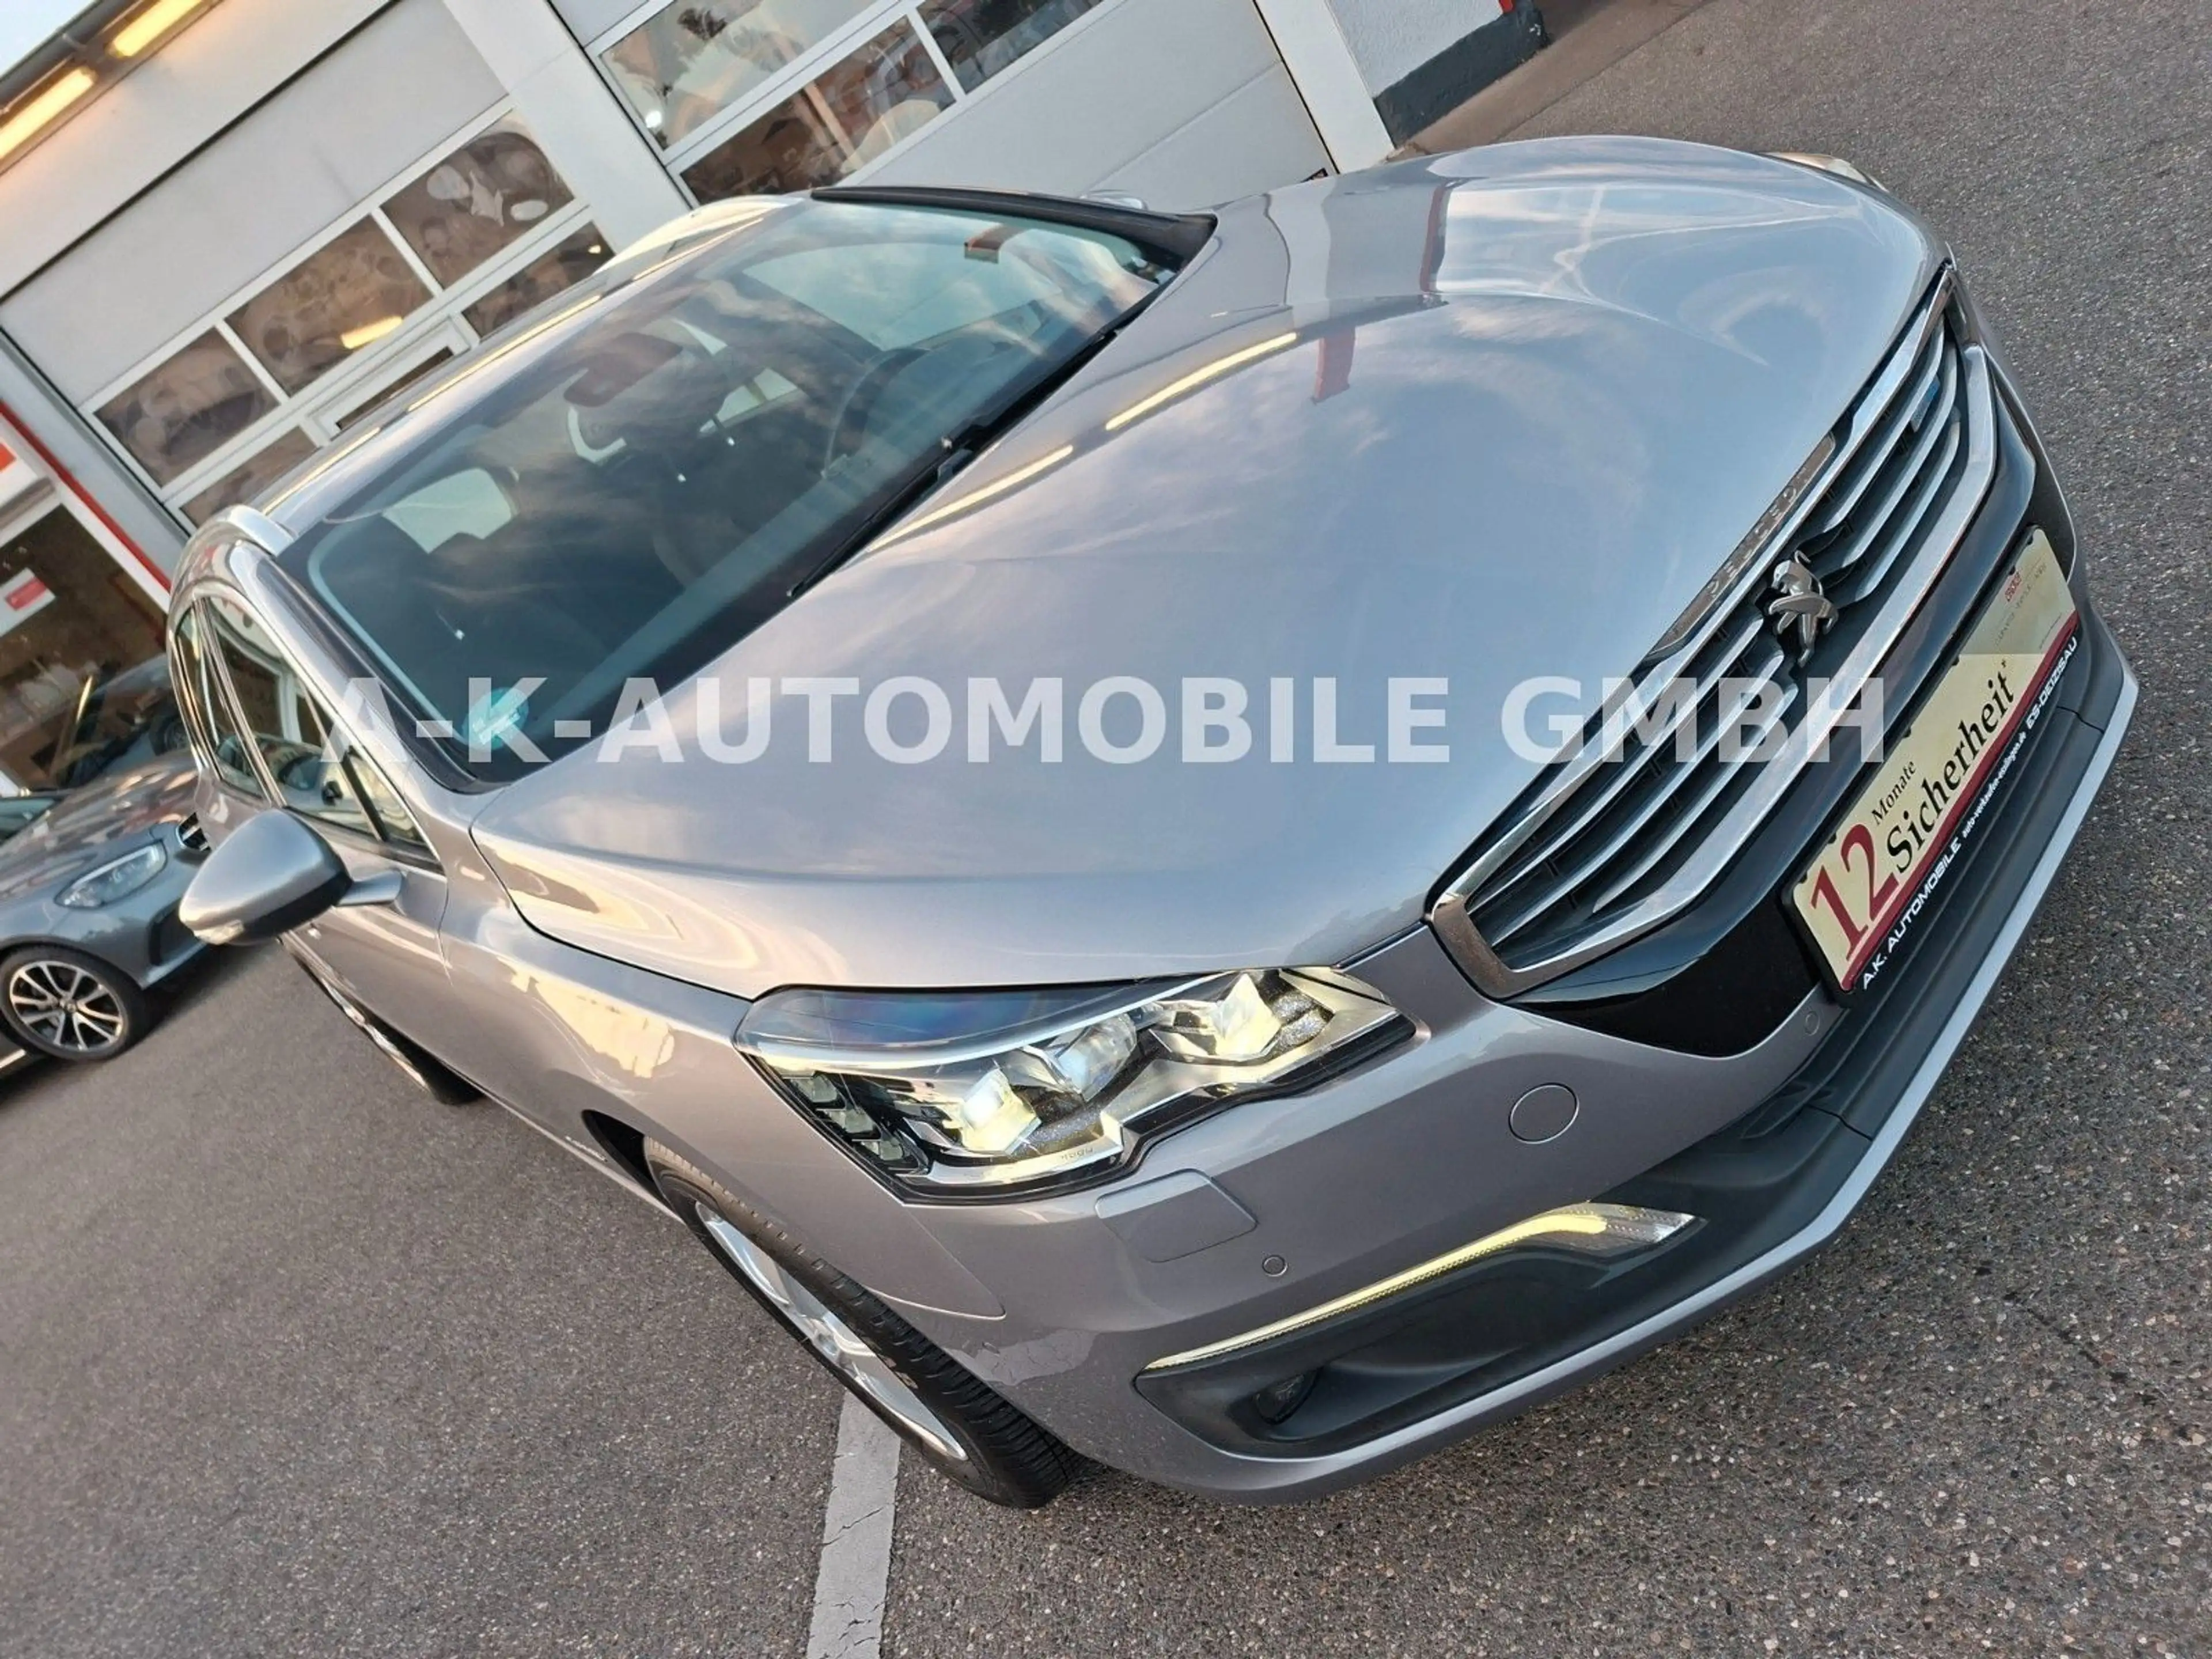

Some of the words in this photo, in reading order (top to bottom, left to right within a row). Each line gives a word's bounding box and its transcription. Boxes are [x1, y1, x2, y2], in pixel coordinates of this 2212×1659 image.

[1861, 954, 1888, 988] A.K.
[1886, 840, 1961, 953] AUTOMOBILE
[2027, 636, 2078, 730] ES-DEIZISAU
[1872, 760, 1916, 826] Monate
[1810, 823, 1900, 960] 12
